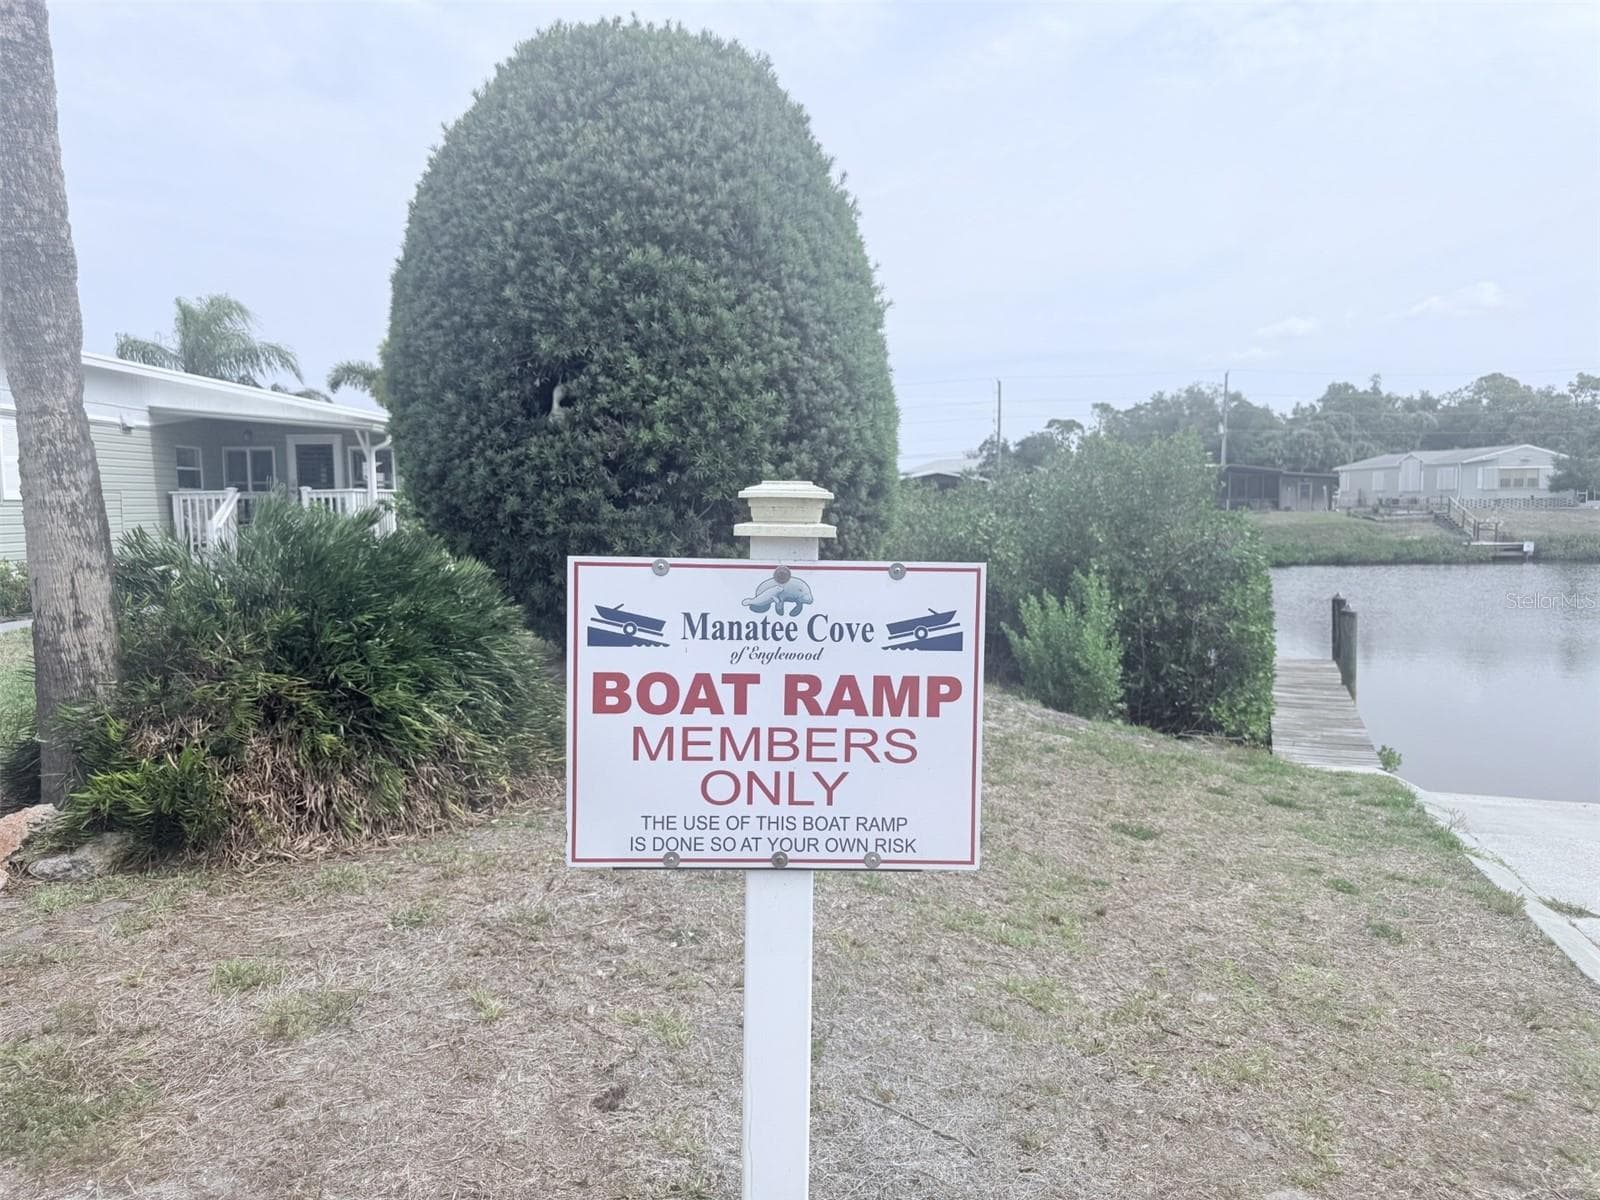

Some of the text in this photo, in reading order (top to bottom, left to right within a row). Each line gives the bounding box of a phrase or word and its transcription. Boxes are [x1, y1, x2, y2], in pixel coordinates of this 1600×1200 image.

[681, 611, 874, 643] Manatee Cove
[730, 646, 824, 664] of Englewood
[592, 672, 962, 717] BOAT RAMP
[633, 726, 917, 764] MEMBERS
[701, 770, 849, 806] ONLY
[641, 815, 907, 832] THE USE OF THIS BOAT RAMP
[630, 837, 916, 853] IS DONE SO AT YOUR OWN RISK
